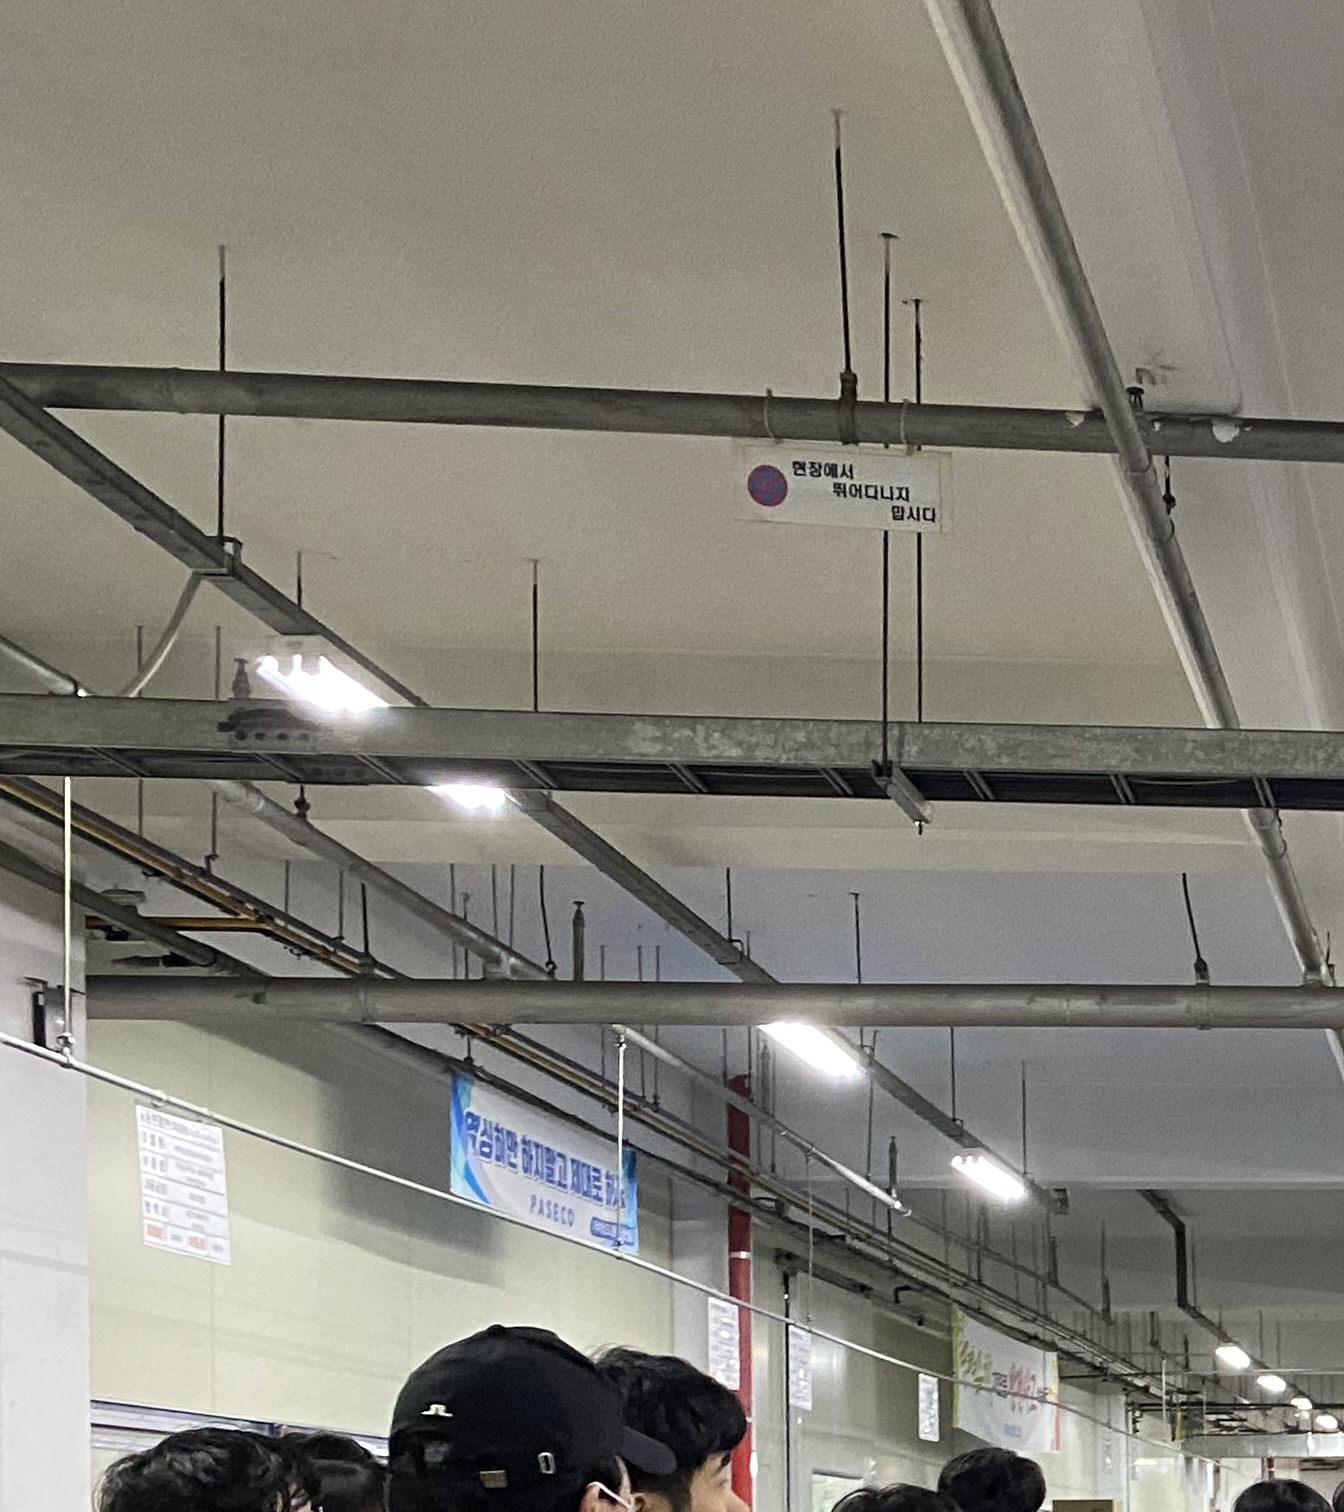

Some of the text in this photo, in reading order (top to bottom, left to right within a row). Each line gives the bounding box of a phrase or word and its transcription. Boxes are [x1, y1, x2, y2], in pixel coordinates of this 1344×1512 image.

[792, 460, 854, 480] 현장에서
[832, 482, 910, 502] 뛰어다니지
[891, 505, 936, 523] 맙시다
[529, 1194, 575, 1228] PASECO
